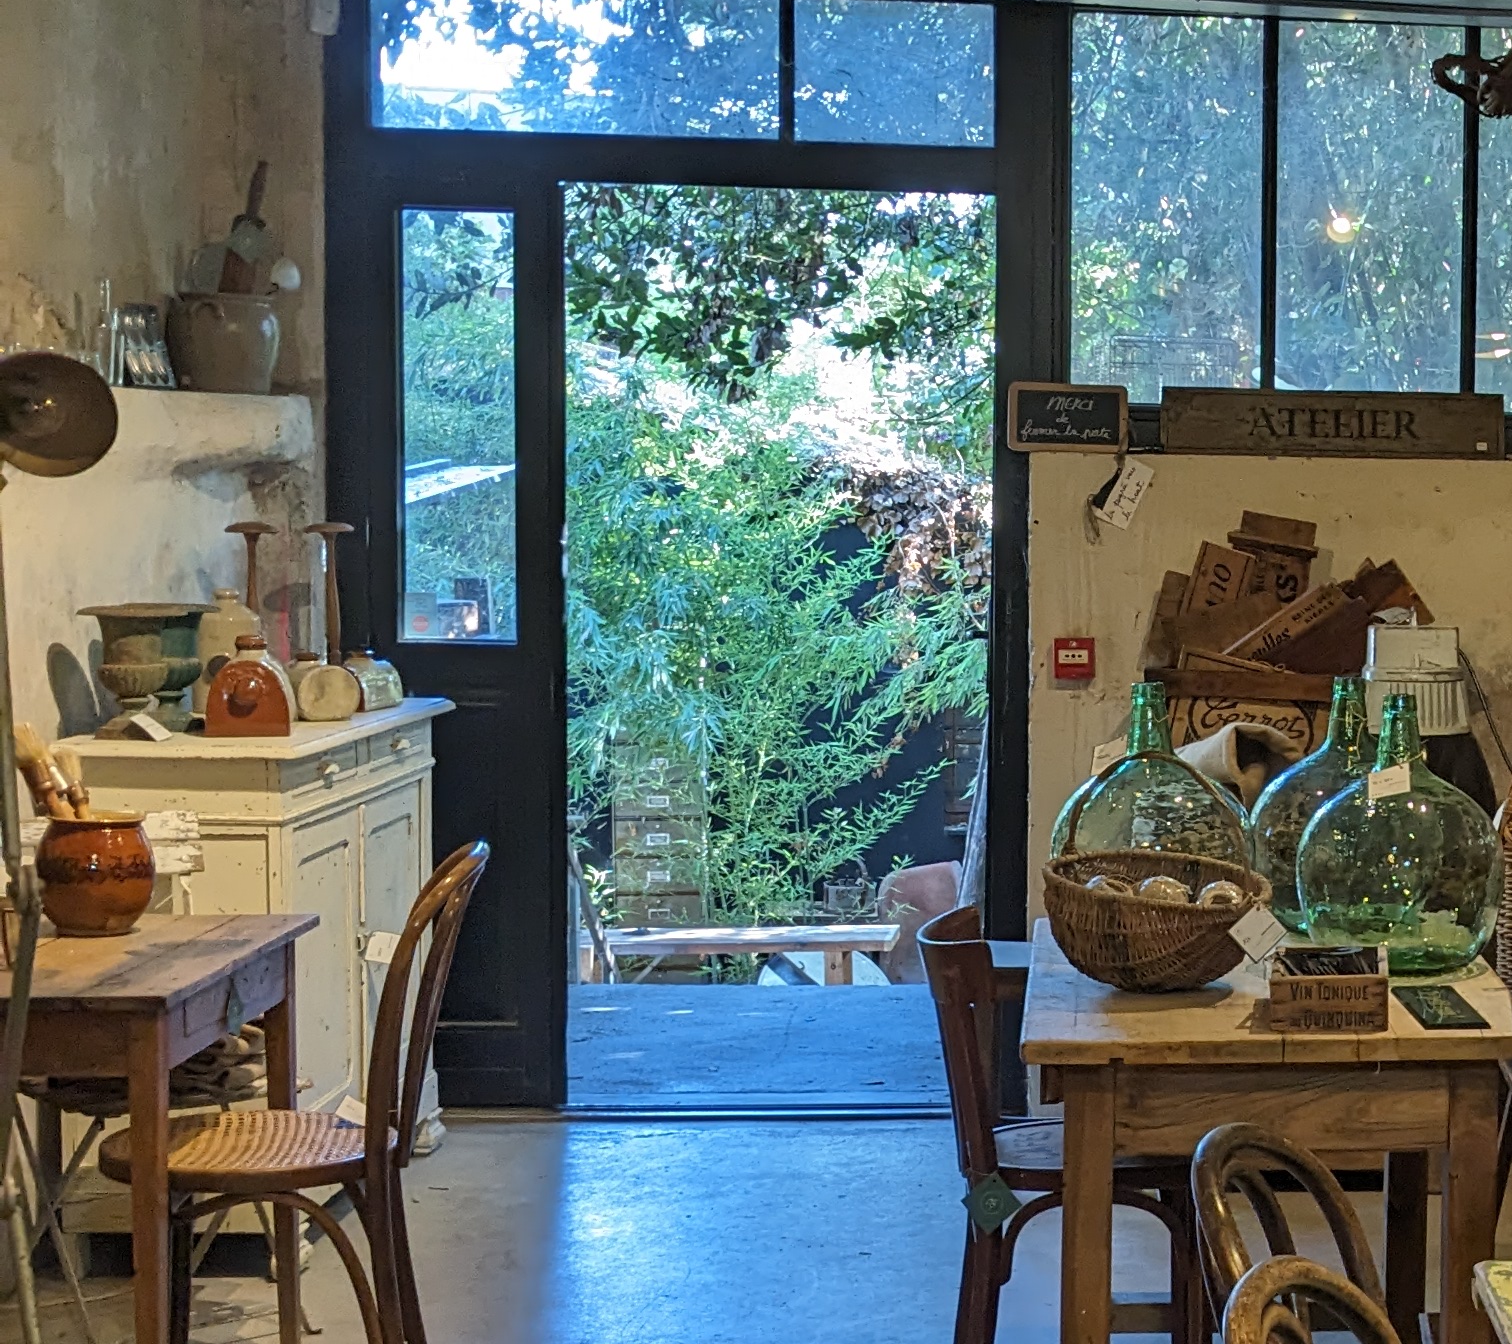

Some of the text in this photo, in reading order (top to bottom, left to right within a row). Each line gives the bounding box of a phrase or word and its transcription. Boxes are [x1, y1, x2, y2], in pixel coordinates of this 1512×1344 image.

[1248, 406, 1420, 441] ATELIER
[1290, 980, 1369, 1003] VIN TONIQUE
